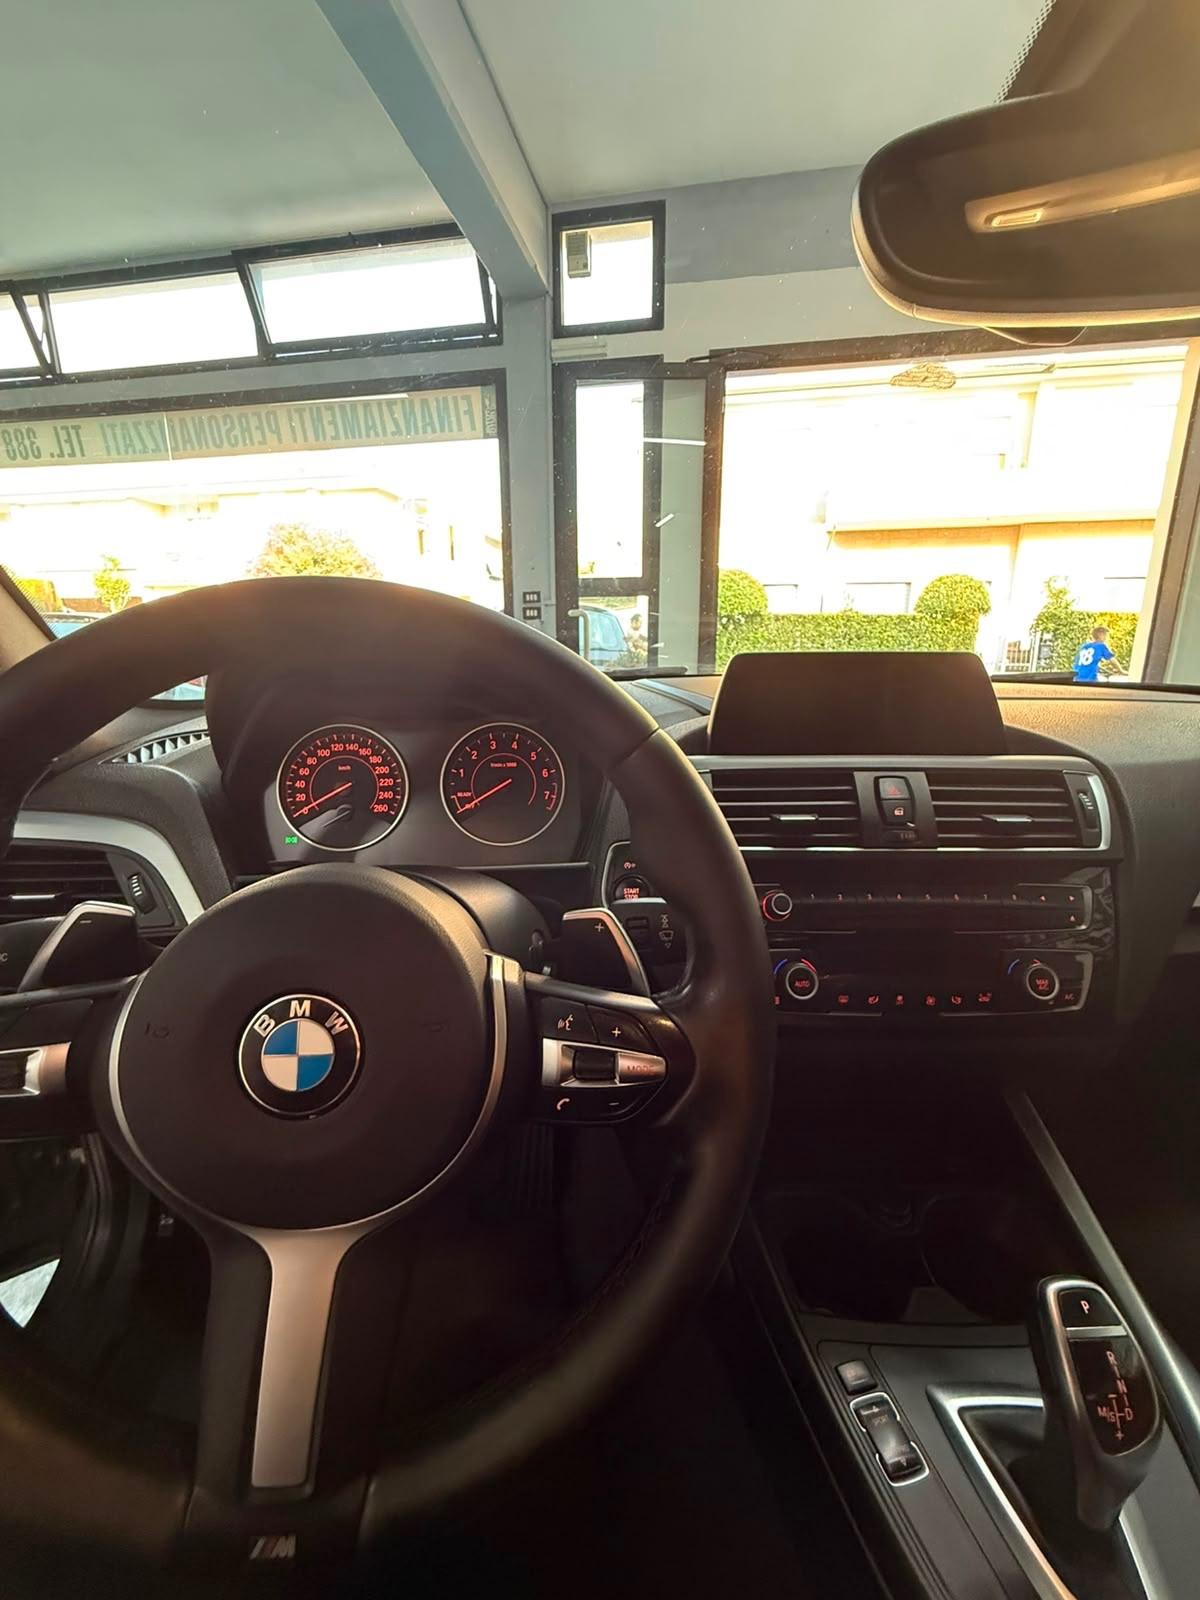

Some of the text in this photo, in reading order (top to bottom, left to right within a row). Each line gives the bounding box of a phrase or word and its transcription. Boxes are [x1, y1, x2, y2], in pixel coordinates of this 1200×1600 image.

[1079, 647, 1095, 666] 18
[330, 743, 344, 751] 120
[345, 743, 359, 751] 140
[490, 740, 496, 750] 3
[511, 741, 518, 750] 4
[317, 749, 331, 757] 100
[358, 748, 372, 756] 160
[471, 750, 478, 760] 2
[530, 751, 537, 761] 5
[306, 757, 317, 765] 80
[368, 755, 383, 764] 180
[299, 767, 310, 776] 60
[375, 766, 390, 774] 200
[459, 768, 464, 778] 1
[542, 768, 549, 778] 6
[295, 780, 305, 788] 40
[379, 778, 394, 786] 220
[295, 793, 306, 802] 20
[378, 791, 394, 799] 240
[544, 791, 550, 800] 7
[373, 804, 388, 813] 260
[794, 980, 810, 988] AUTO
[253, 1000, 349, 1038] BMW
[1081, 1300, 1090, 1314] P
[1106, 1351, 1117, 1365] R
[1116, 1379, 1128, 1393] N
[1123, 1408, 1134, 1421] D
